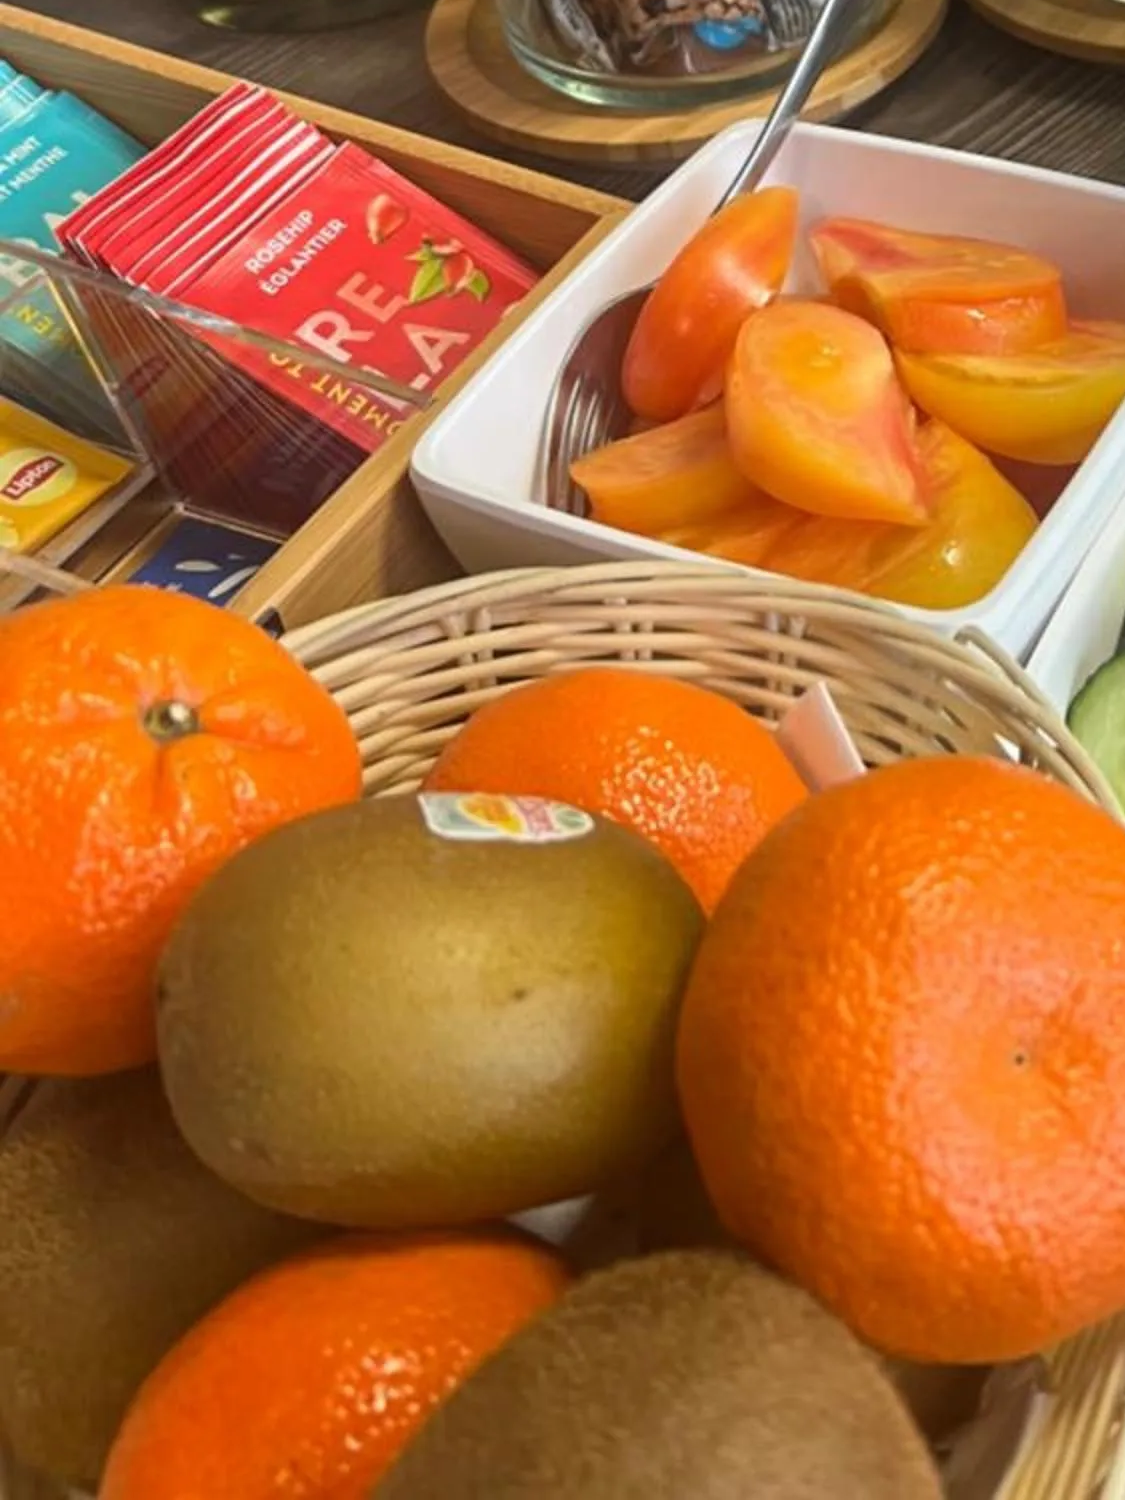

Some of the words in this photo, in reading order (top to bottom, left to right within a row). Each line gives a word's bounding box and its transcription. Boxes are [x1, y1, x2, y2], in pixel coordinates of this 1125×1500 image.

[8, 146, 69, 191] MENTHE
[244, 209, 315, 275] ROSEHIP
[5, 458, 58, 497] Lipton
